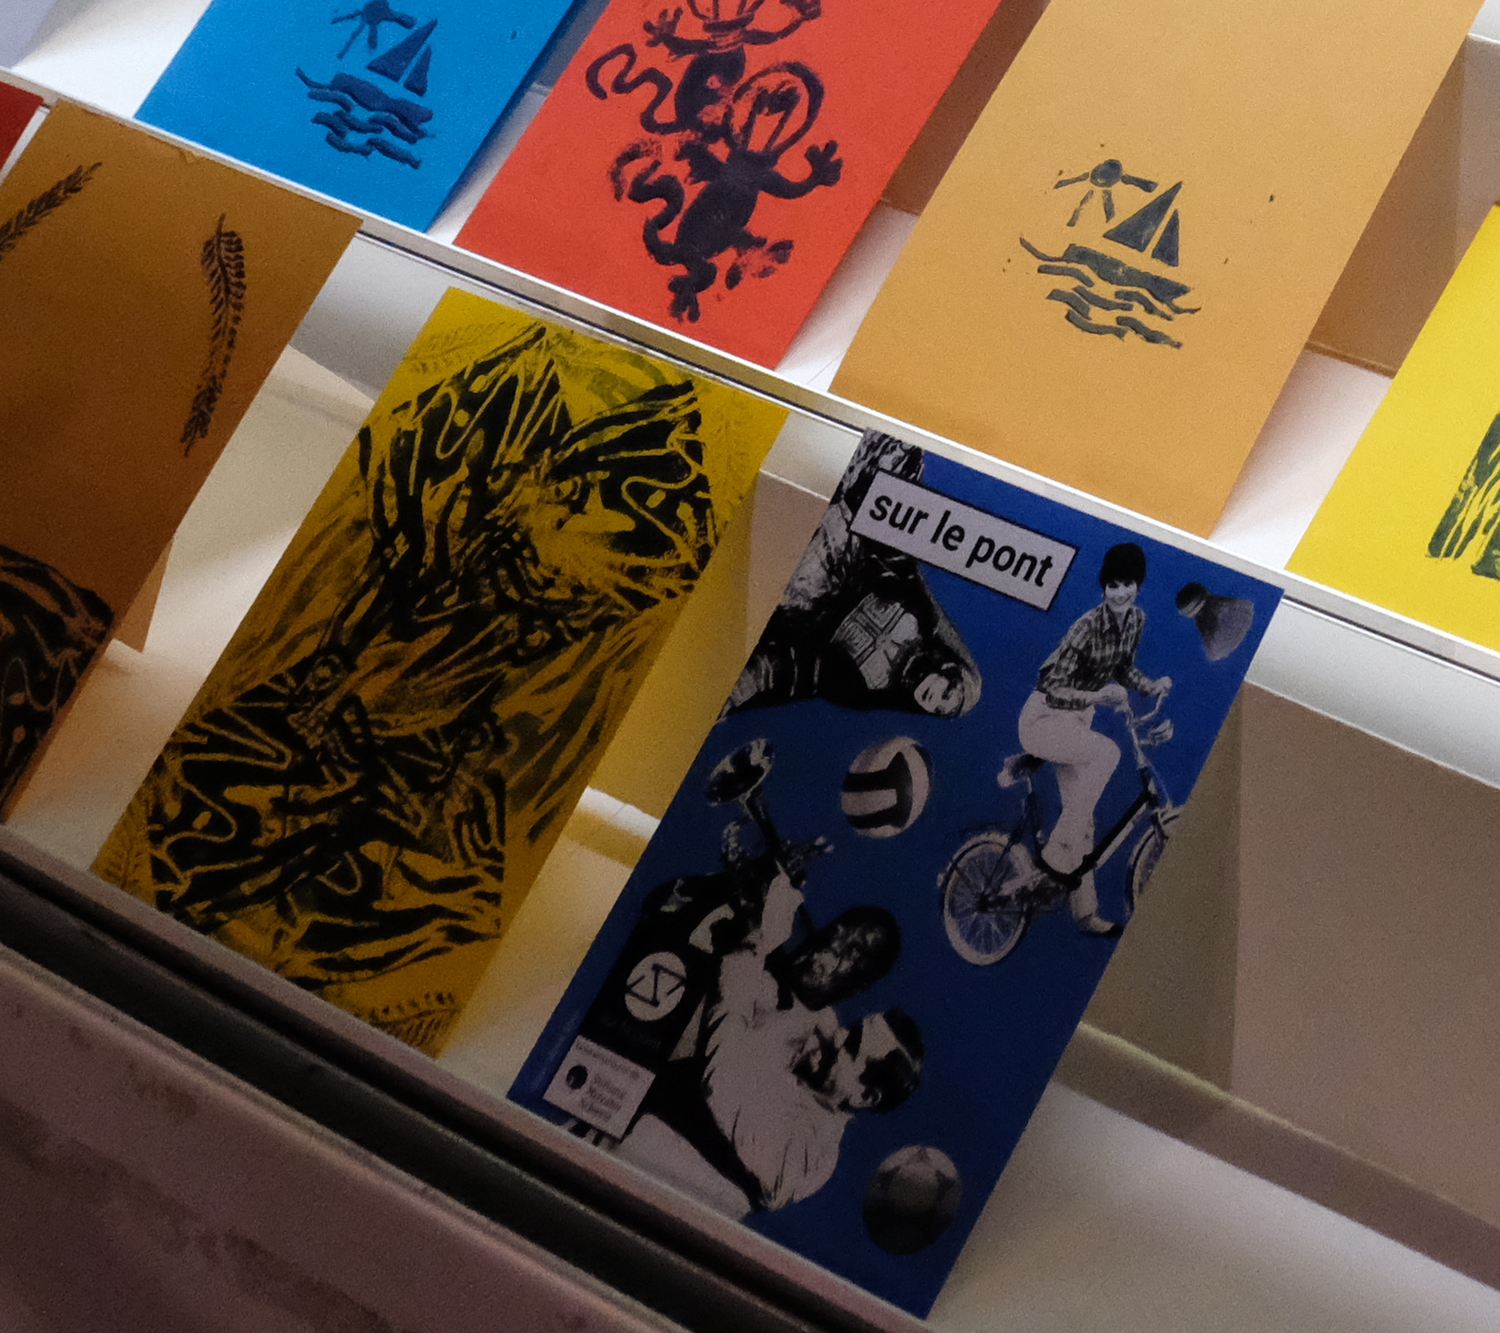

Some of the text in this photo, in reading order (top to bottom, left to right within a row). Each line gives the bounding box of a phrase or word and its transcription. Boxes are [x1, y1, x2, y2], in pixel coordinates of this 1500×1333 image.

[868, 494, 1054, 588] sur le pont
